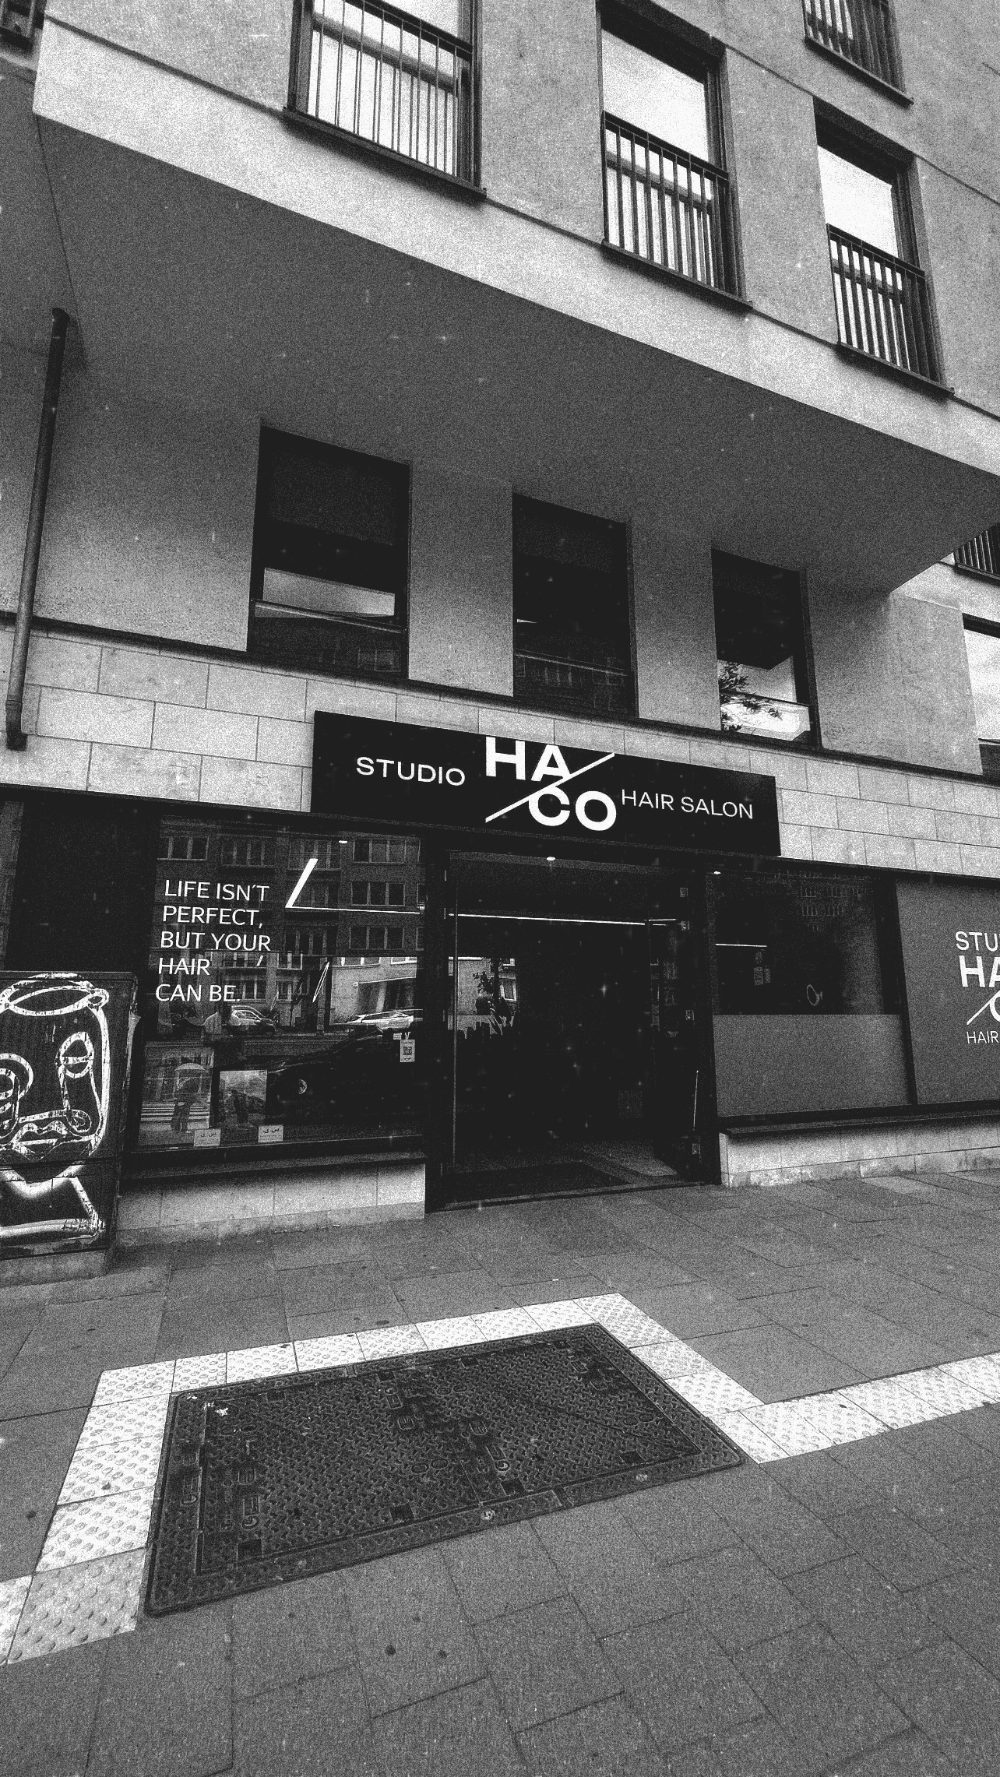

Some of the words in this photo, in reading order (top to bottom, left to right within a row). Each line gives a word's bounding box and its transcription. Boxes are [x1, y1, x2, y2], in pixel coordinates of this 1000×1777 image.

[485, 737, 571, 782] HA
[356, 756, 466, 787] STUDIO
[528, 786, 617, 832] CO
[620, 788, 674, 812] HAIR
[680, 795, 754, 821] SALON
[164, 879, 211, 899] LIFE
[162, 905, 262, 929] PERFECT,
[160, 930, 206, 951] BUT
[211, 932, 270, 952] YOUR
[955, 931, 1000, 952] STU
[158, 956, 211, 976] HAIR
[155, 983, 202, 1002] CAN
[966, 1030, 1000, 1044] HAIR
